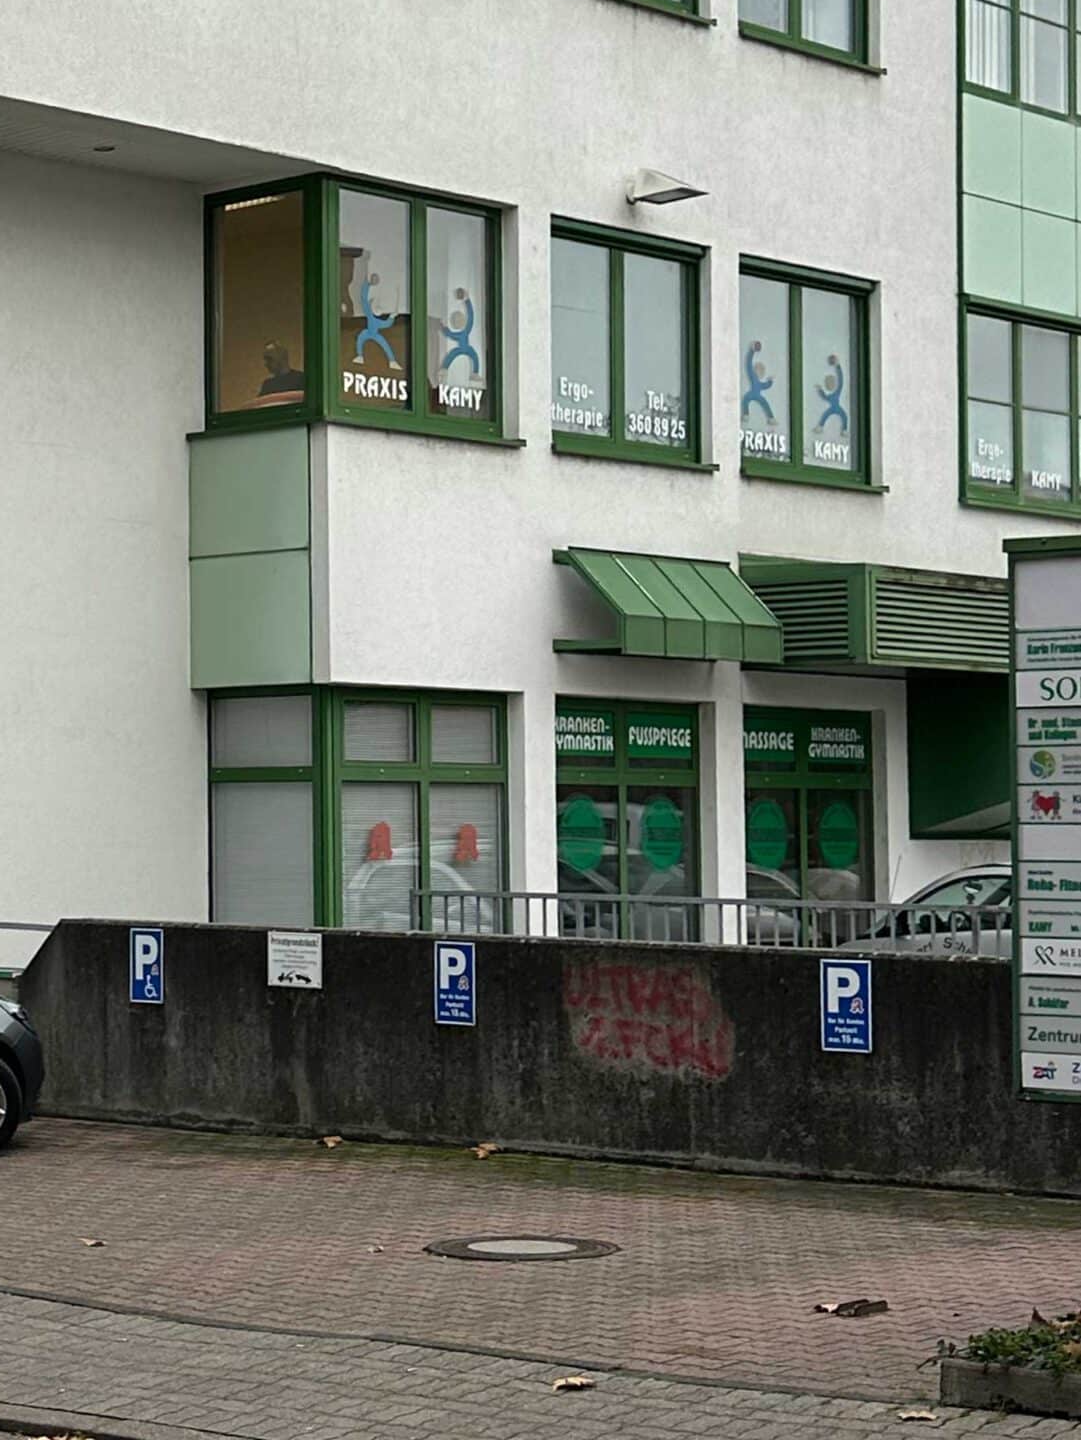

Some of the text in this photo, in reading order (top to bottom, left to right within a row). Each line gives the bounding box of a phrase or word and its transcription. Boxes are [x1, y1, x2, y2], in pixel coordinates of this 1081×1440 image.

[343, 371, 483, 411] PRAXIS KAMY
[560, 376, 594, 402] Ergo-
[647, 390, 668, 412] Tel.
[551, 402, 603, 430] therapie
[629, 413, 686, 439] 360 89 25
[739, 430, 849, 464] PRAXIS KAMY
[977, 438, 1004, 460] Ergo-
[971, 461, 1012, 485] therapie
[1032, 470, 1061, 491] KAMY
[1040, 677, 1081, 701] SO
[554, 716, 610, 733] KRANKEN-
[811, 727, 862, 742] KRANKEN-
[555, 734, 614, 751] YMNASTIK
[628, 726, 691, 748] FUSSPFLEGE
[808, 743, 865, 759] GYMNASTIK
[135, 934, 158, 980] P
[439, 948, 467, 989] P
[827, 967, 860, 1013] P
[1027, 1026, 1081, 1044] Zentru
